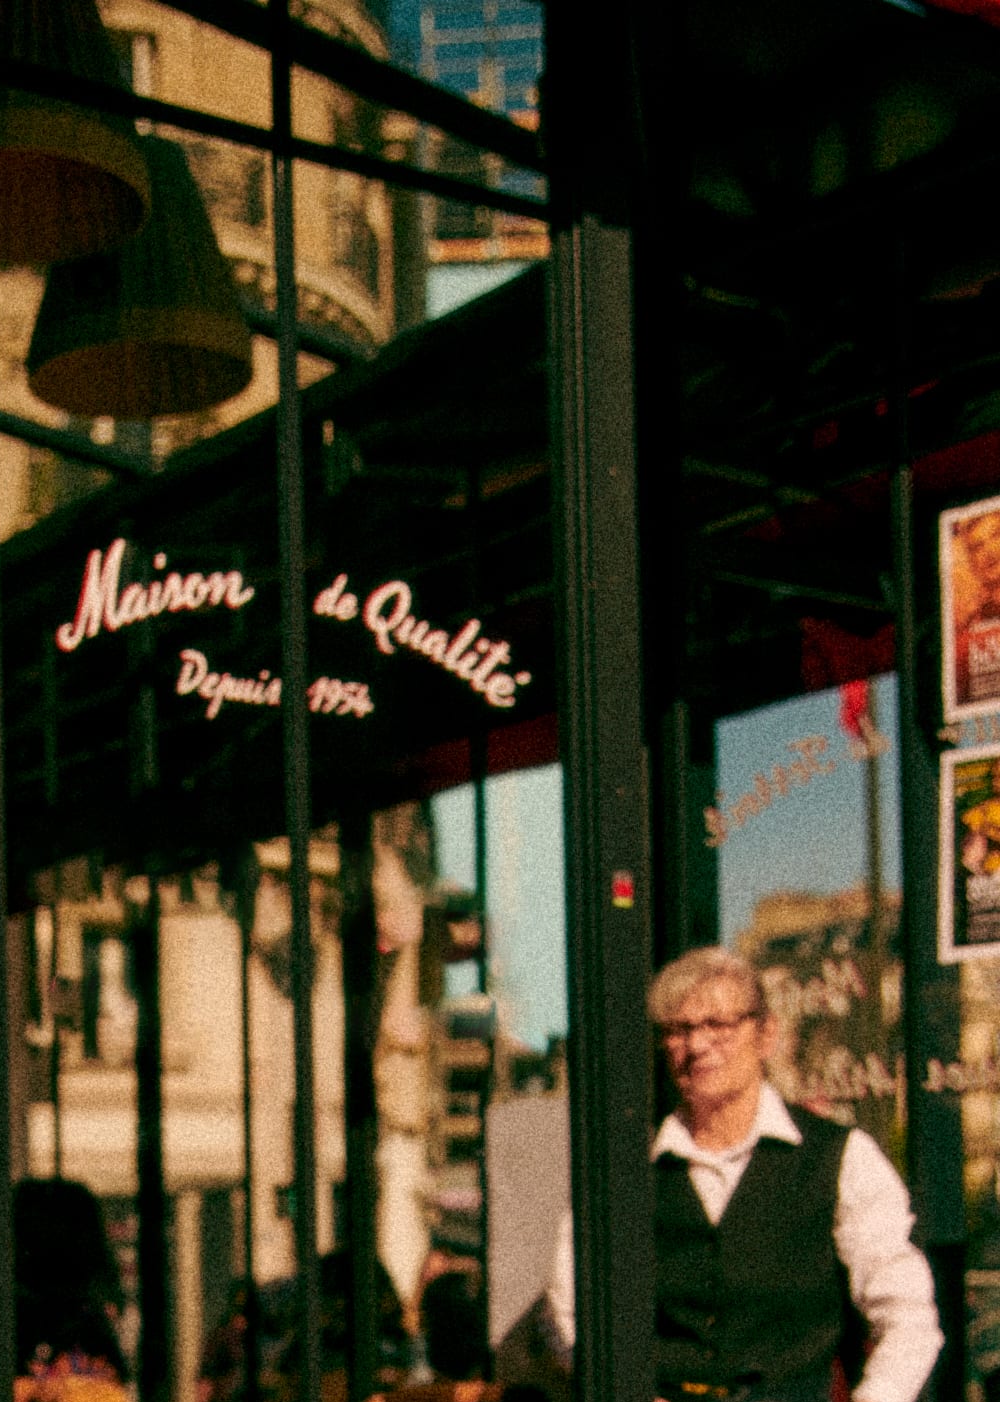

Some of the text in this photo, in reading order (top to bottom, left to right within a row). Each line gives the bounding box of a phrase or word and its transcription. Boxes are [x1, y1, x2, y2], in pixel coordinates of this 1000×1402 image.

[56, 537, 532, 708] Maison de Qualité
[176, 648, 282, 720] Depuis
